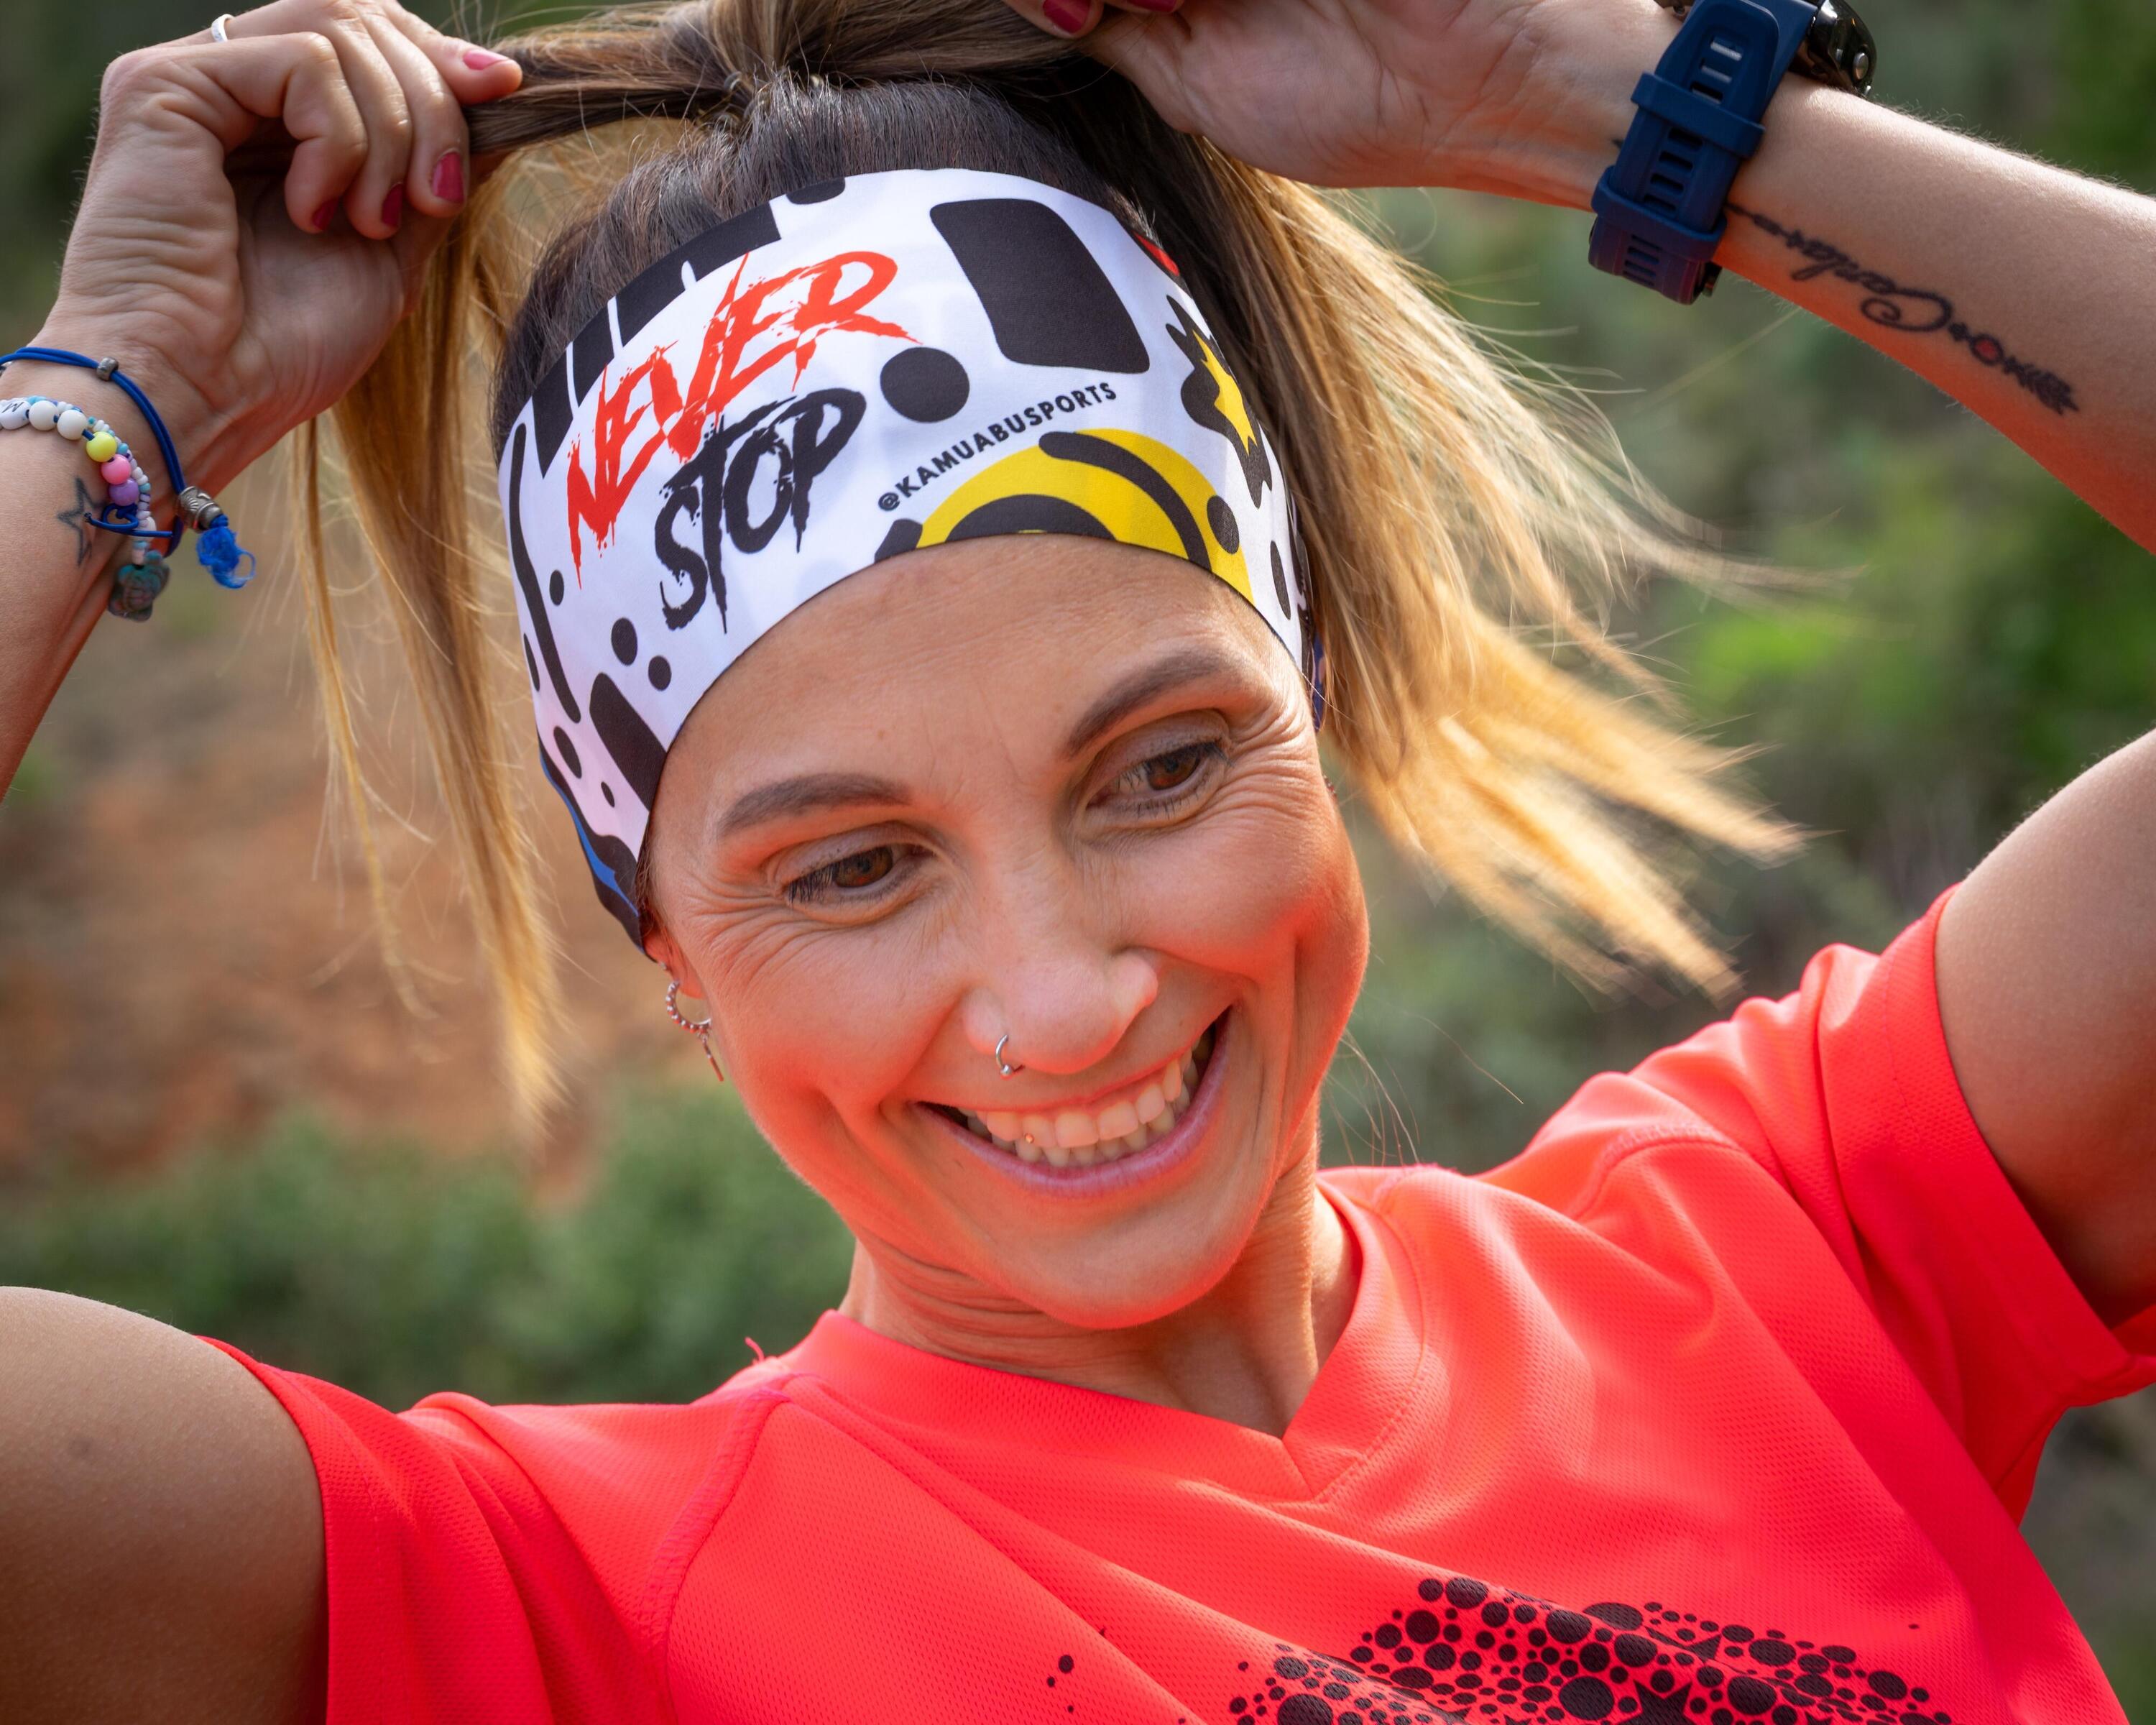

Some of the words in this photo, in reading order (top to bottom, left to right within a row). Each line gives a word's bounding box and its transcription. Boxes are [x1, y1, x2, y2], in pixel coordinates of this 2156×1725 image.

[566, 251, 922, 589] NEVER
[653, 387, 867, 634] STOP
[878, 382, 1118, 512] @KAMUABUSPORTS
